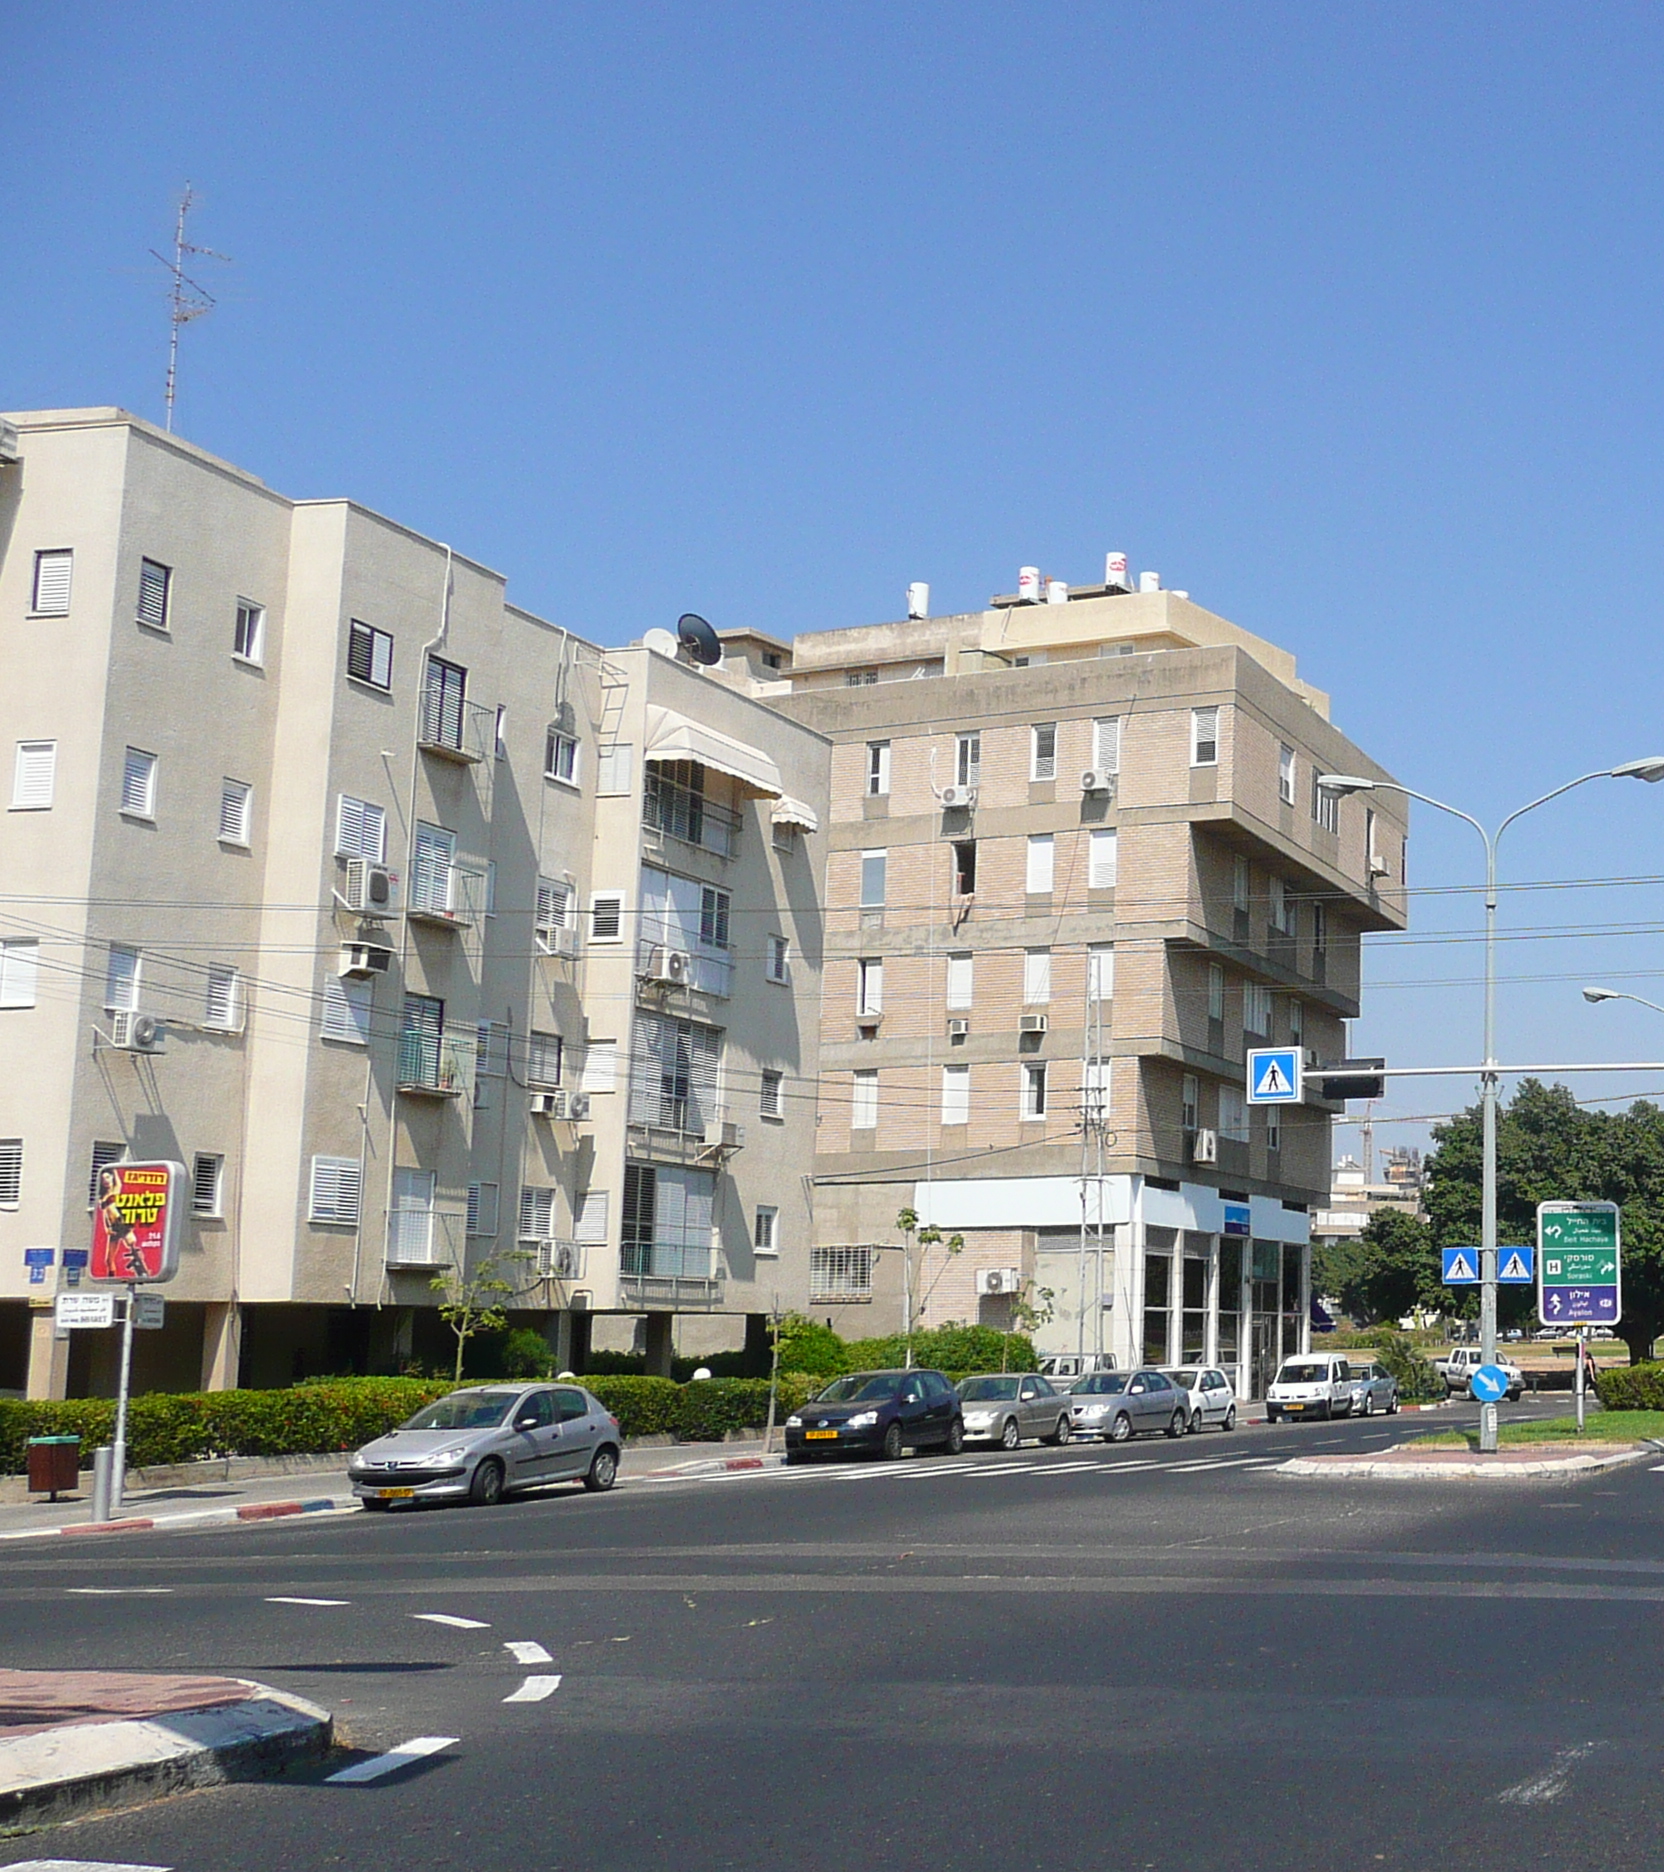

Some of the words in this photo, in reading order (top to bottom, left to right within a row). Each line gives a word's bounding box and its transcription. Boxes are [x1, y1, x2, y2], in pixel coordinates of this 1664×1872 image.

[127, 1172, 164, 1183] רודריגז
[115, 1190, 166, 1208] פלאנט
[121, 1208, 159, 1224] טרור
[1564, 1254, 1595, 1263] סורסקי
[1549, 1262, 1559, 1272] H
[1569, 1290, 1591, 1300] אילון
